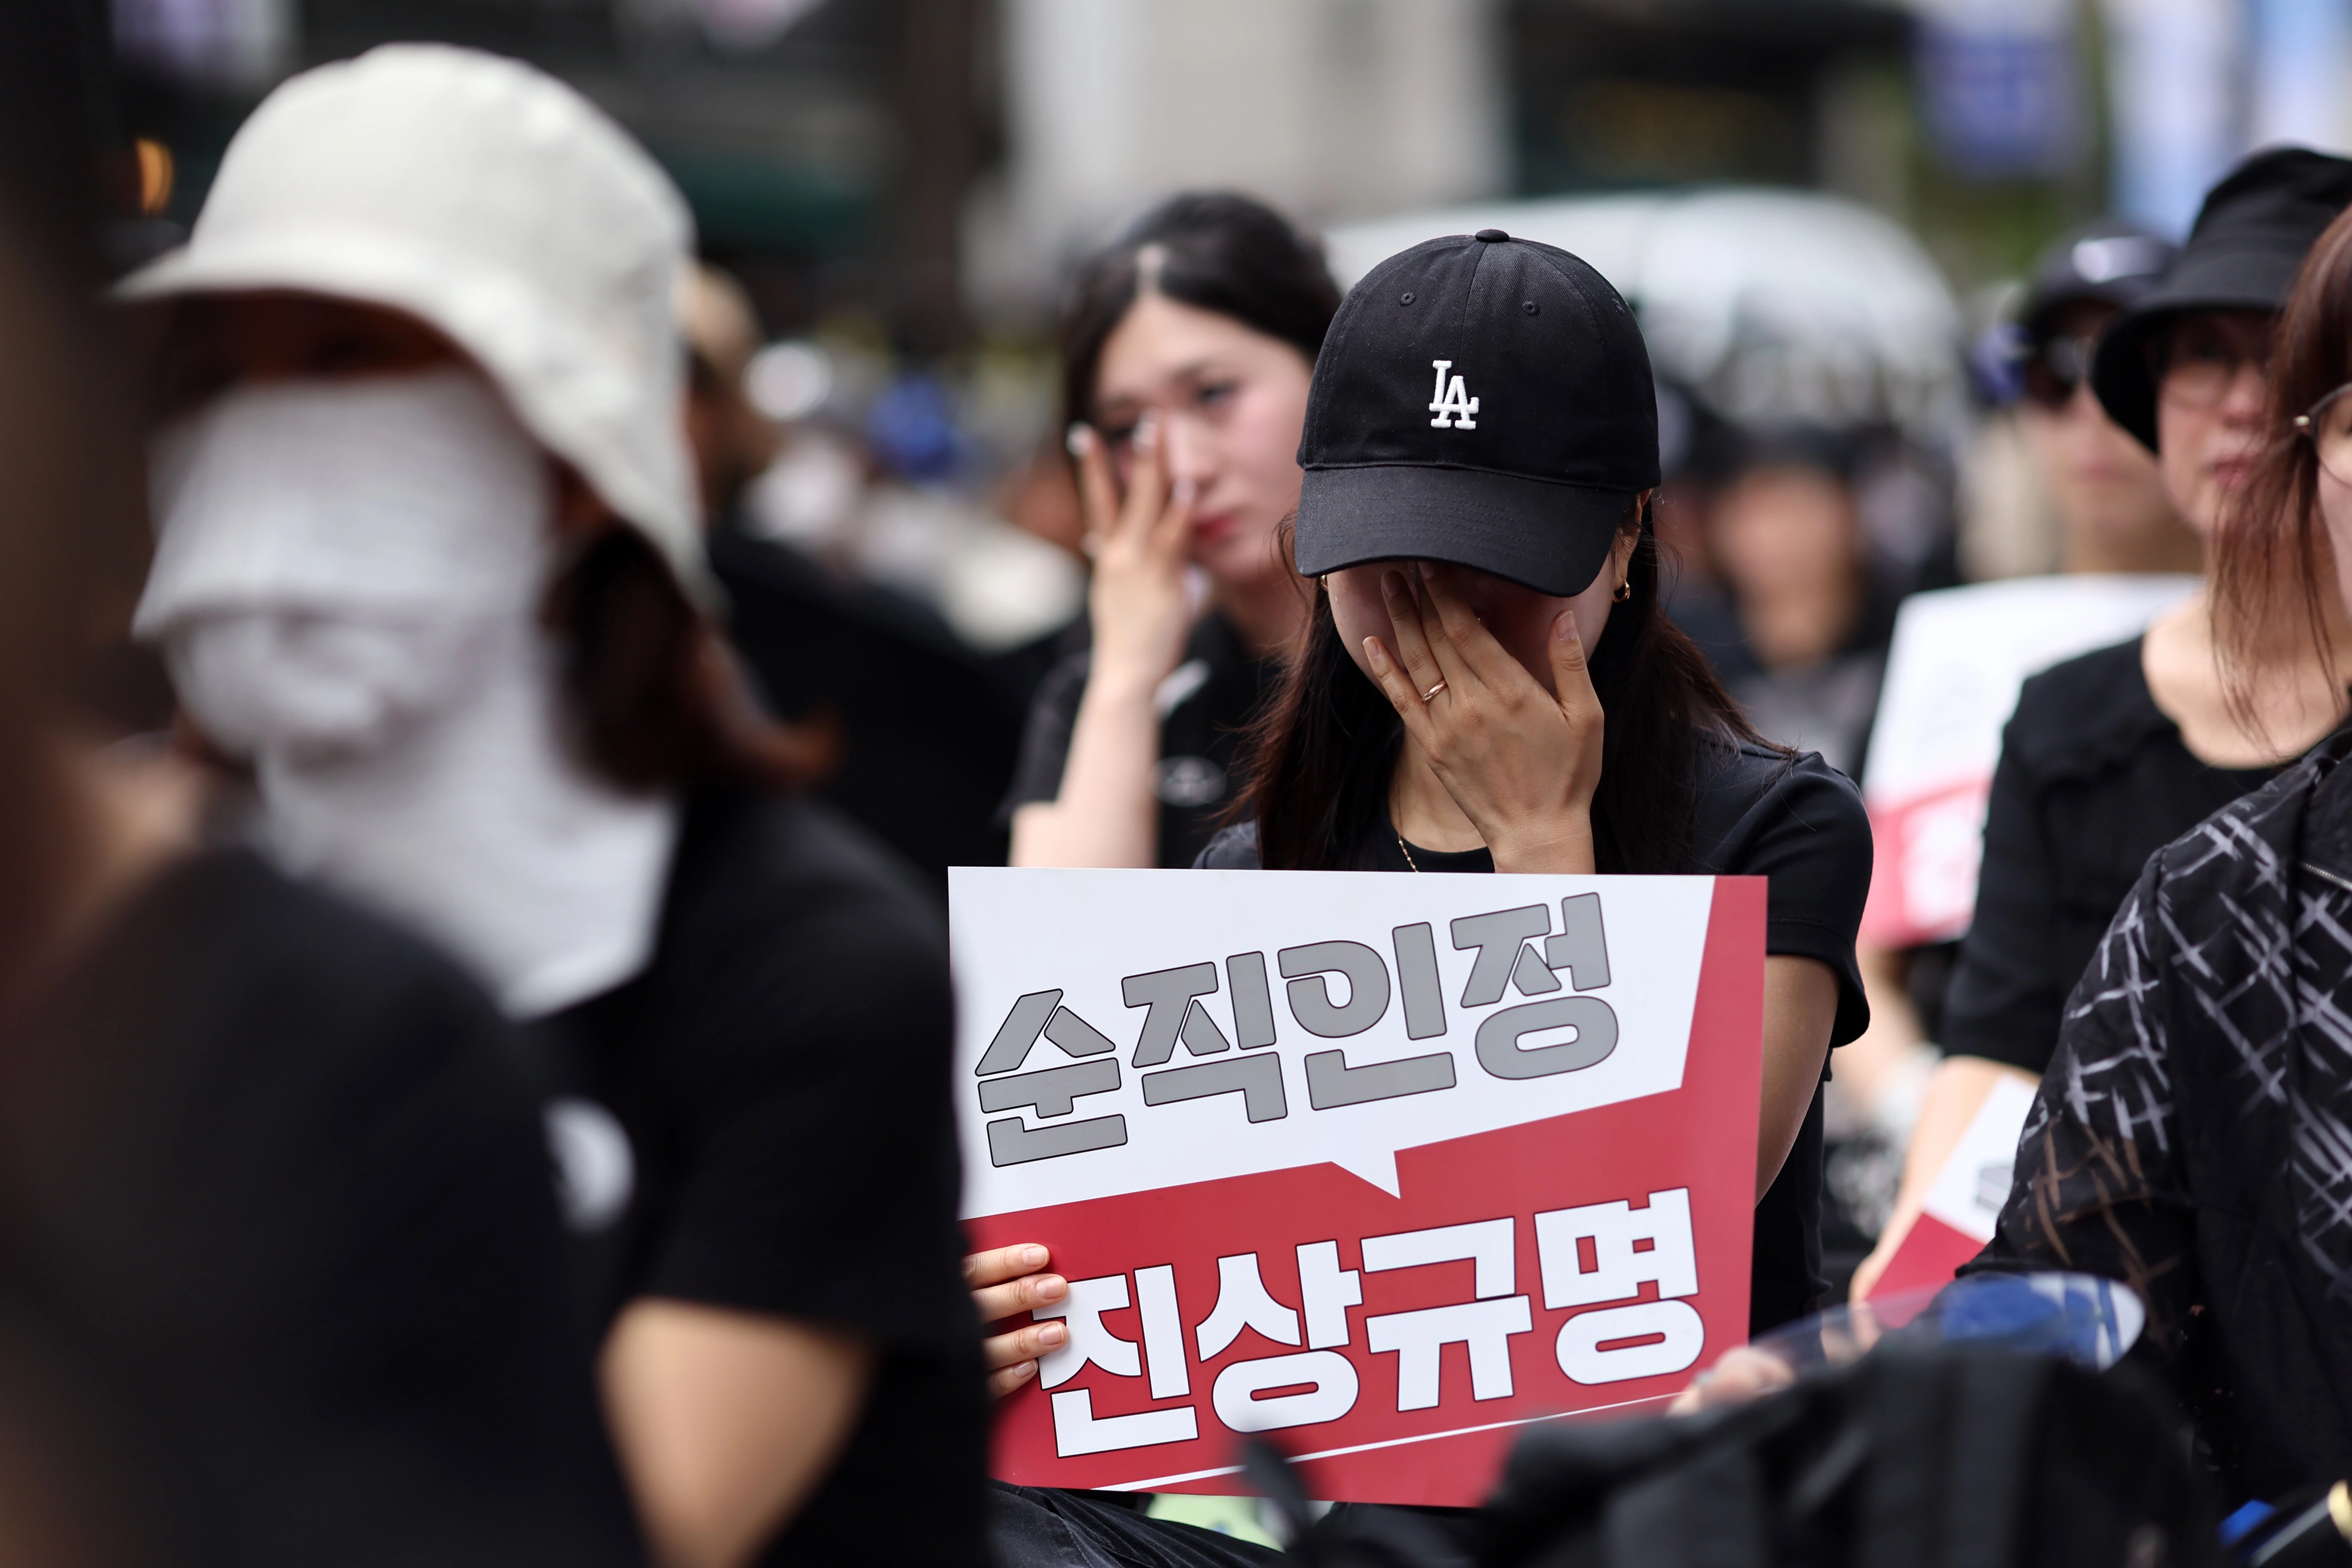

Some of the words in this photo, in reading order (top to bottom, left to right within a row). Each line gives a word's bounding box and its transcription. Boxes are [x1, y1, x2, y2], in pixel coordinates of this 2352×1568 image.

[1429, 360, 1479, 430] LA
[975, 892, 1619, 1168] 순직인정
[1032, 1186, 1705, 1458] 진상규명
